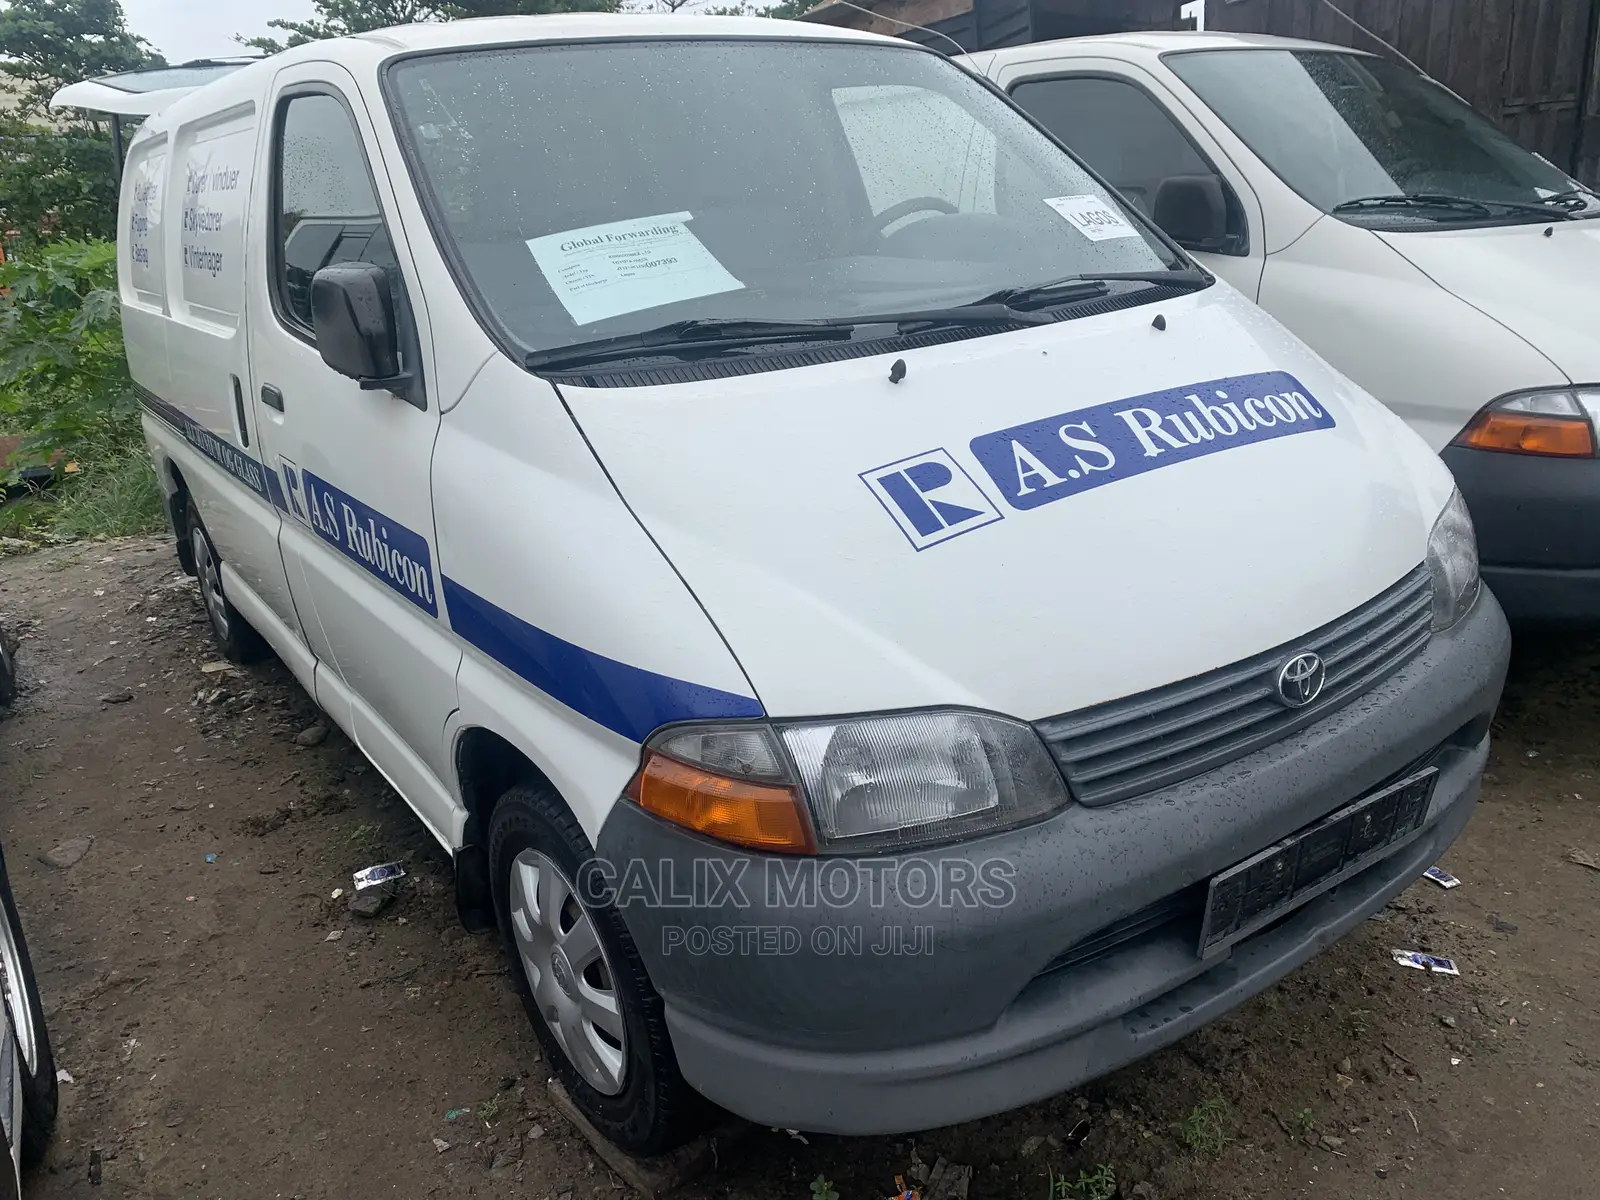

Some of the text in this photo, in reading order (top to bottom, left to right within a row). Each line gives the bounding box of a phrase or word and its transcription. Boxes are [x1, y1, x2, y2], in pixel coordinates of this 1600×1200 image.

[560, 235, 604, 252] Global
[605, 223, 680, 242] Forwarding
[1070, 209, 1120, 227] LAGOS
[234, 453, 262, 492] GLASS
[876, 388, 1323, 537] R A.S Rubicon
[311, 483, 341, 542] A.S
[341, 501, 433, 604] Rubicon
